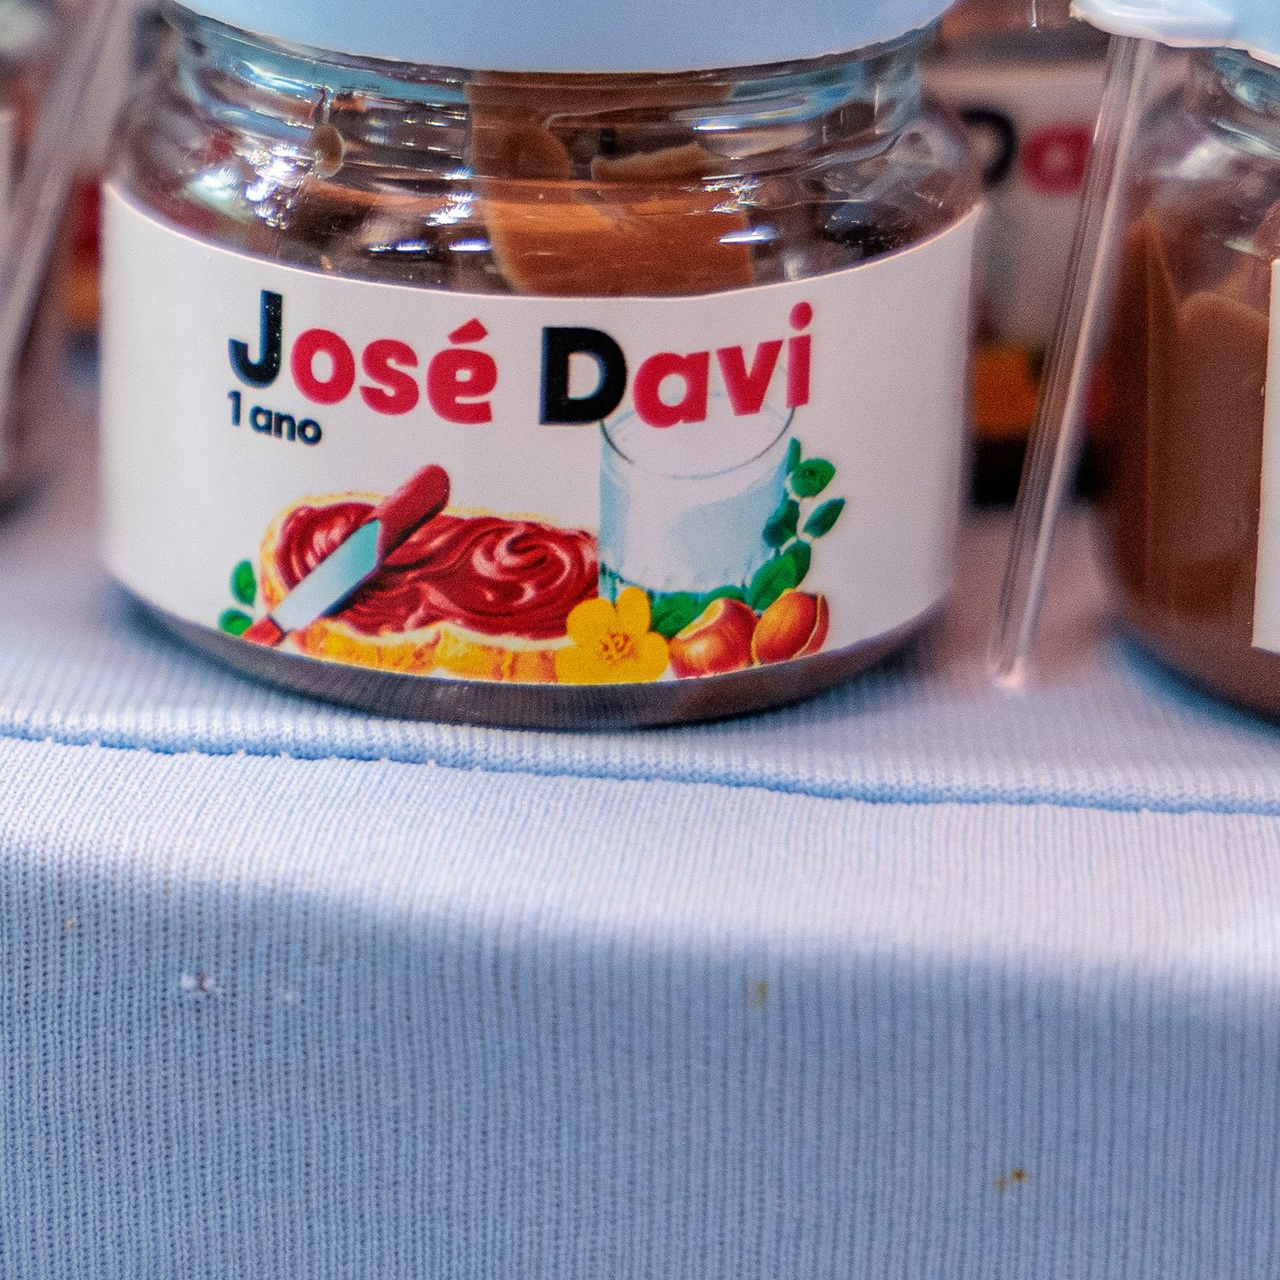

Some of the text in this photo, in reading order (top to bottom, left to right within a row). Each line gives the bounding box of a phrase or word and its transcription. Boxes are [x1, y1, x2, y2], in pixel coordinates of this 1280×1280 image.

[228, 290, 814, 429] José Davi
[227, 391, 323, 447] 1 ano
